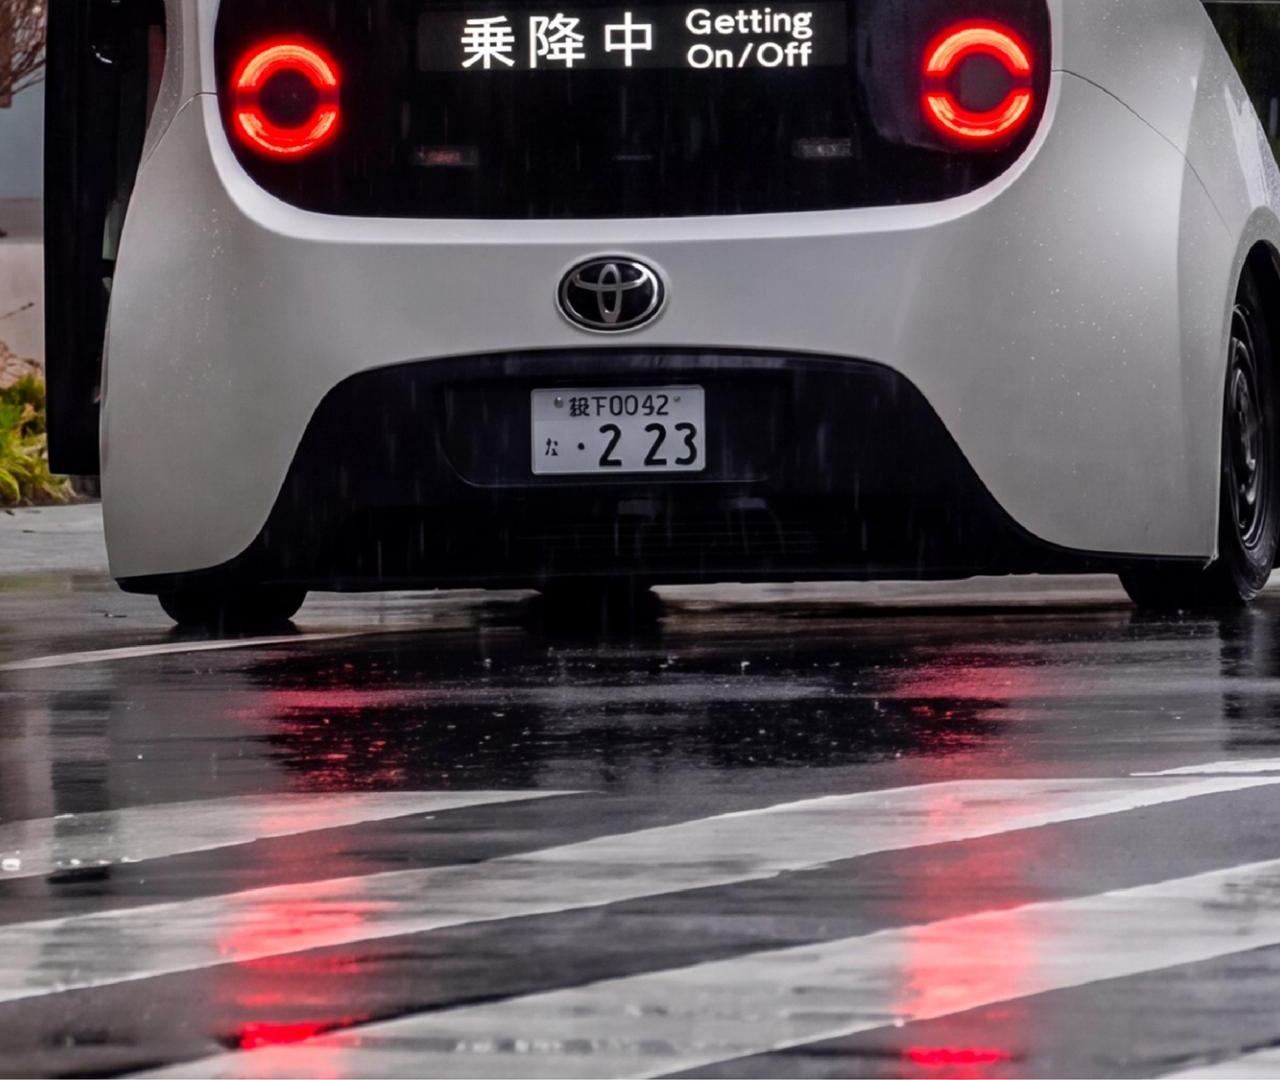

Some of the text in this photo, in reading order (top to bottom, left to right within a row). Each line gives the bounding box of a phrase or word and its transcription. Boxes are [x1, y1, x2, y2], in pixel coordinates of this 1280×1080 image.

[686, 8, 813, 39] Getting
[461, 12, 652, 69] 乗降中
[687, 42, 812, 68] On/Off
